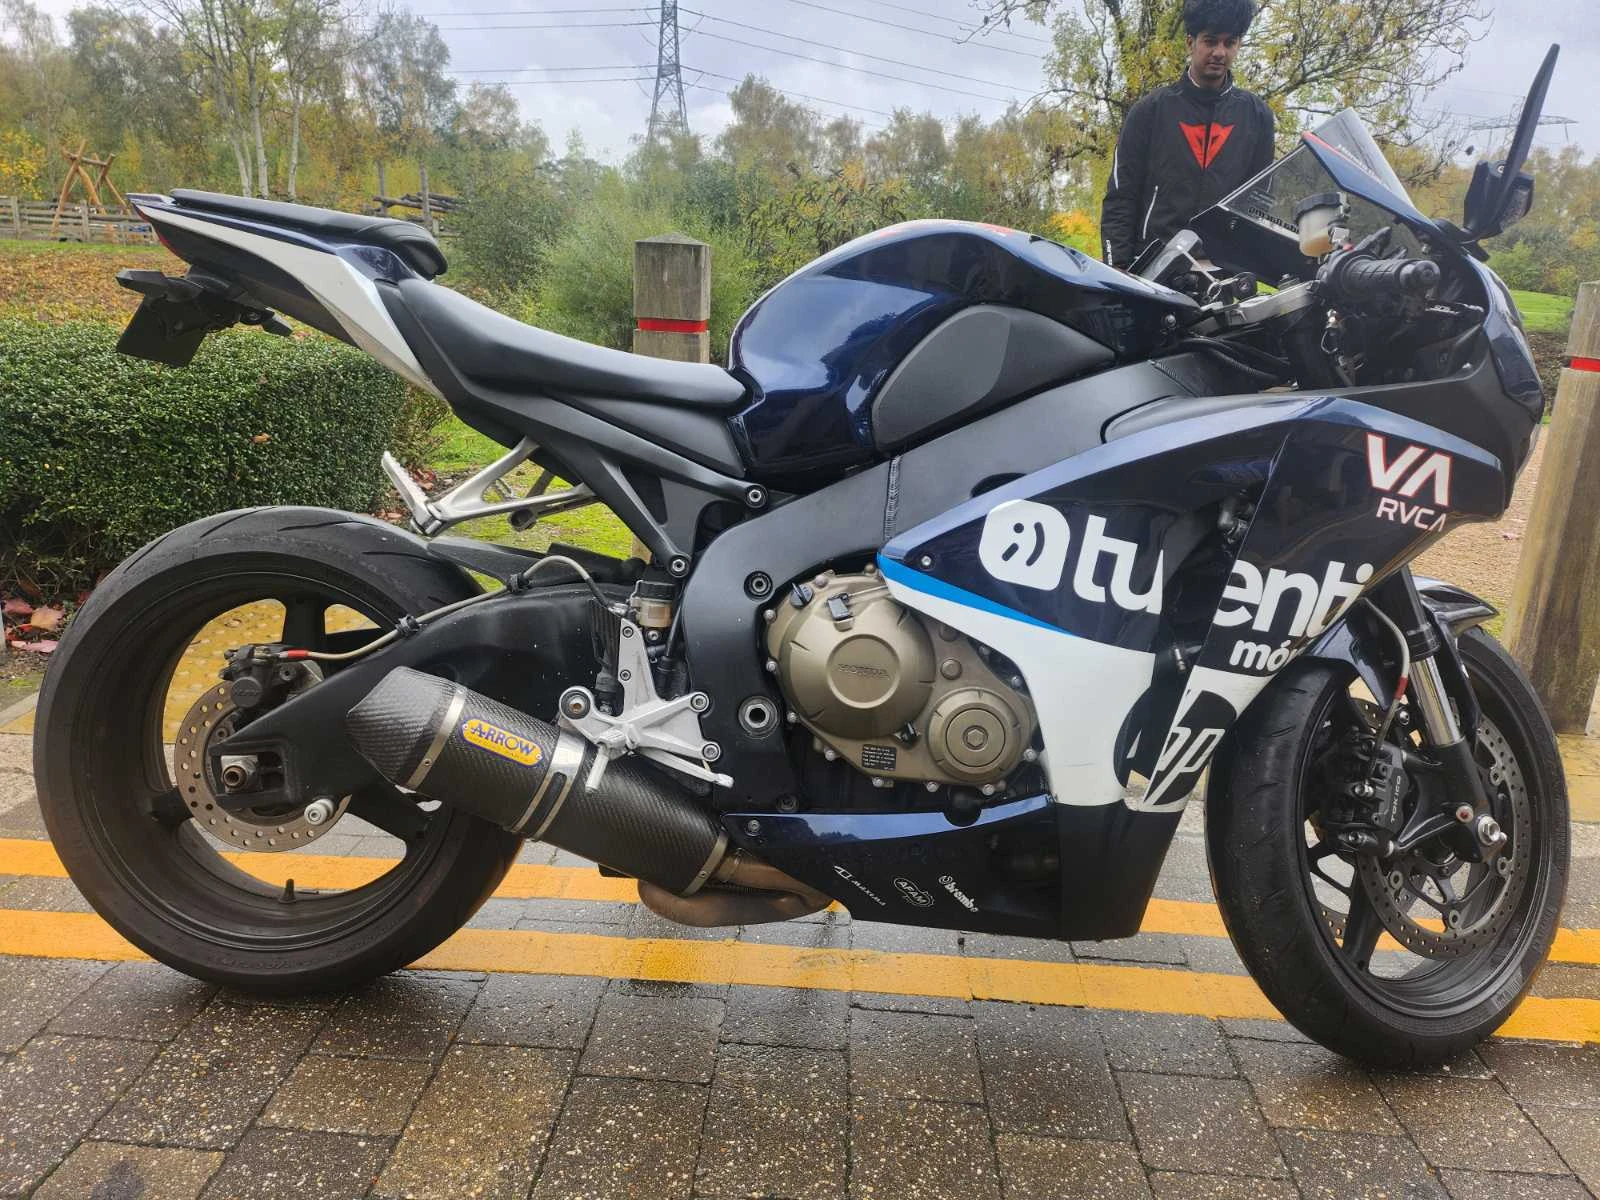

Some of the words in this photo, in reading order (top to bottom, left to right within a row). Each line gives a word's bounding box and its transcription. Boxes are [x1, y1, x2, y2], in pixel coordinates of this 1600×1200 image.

[1376, 496, 1447, 532] RVCA
[471, 723, 535, 755] ARROW
[898, 880, 928, 904] AFAM
[944, 881, 980, 913] brembo
